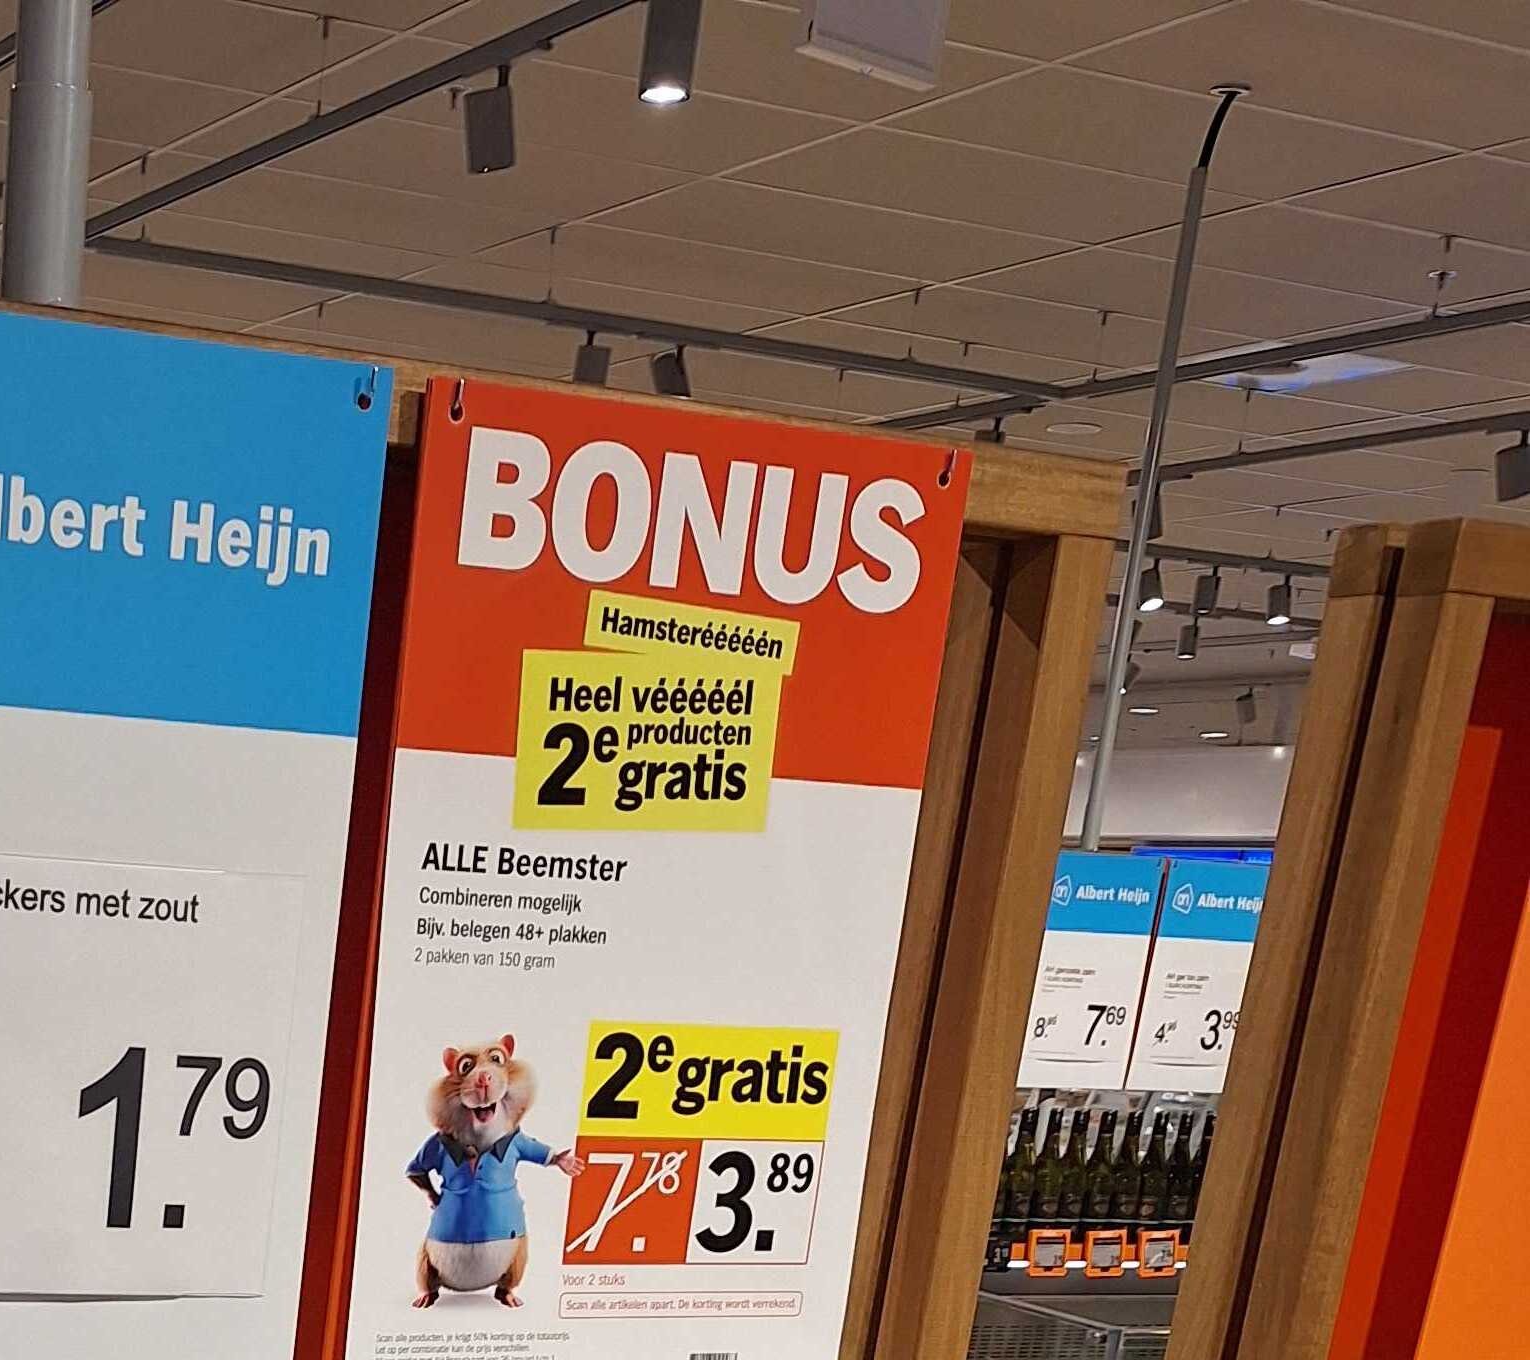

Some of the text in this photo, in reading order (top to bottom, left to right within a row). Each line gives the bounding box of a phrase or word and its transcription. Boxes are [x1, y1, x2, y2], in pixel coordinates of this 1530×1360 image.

[457, 425, 927, 615] BONUS
[169, 498, 331, 587] Heijn
[601, 606, 783, 659] Hamsterééééén
[549, 675, 754, 715] Heel vééééél
[627, 717, 752, 750] producten
[614, 749, 748, 812] gratis
[421, 842, 628, 882] ALLE Beemster
[76, 888, 131, 918] met
[138, 893, 200, 924] zout
[419, 886, 583, 916] Combineren mogelijk
[1076, 884, 1150, 906] Albert Heijn
[416, 917, 607, 946] Bijv. belegen 48+ plakken
[414, 947, 556, 971] 2 pakken van 150 gram
[1084, 1004, 1126, 1047] 7.69
[586, 1031, 829, 1119] 2e gratis
[695, 1150, 815, 1254] 3.89
[562, 1273, 626, 1287] Voor 2 stuks
